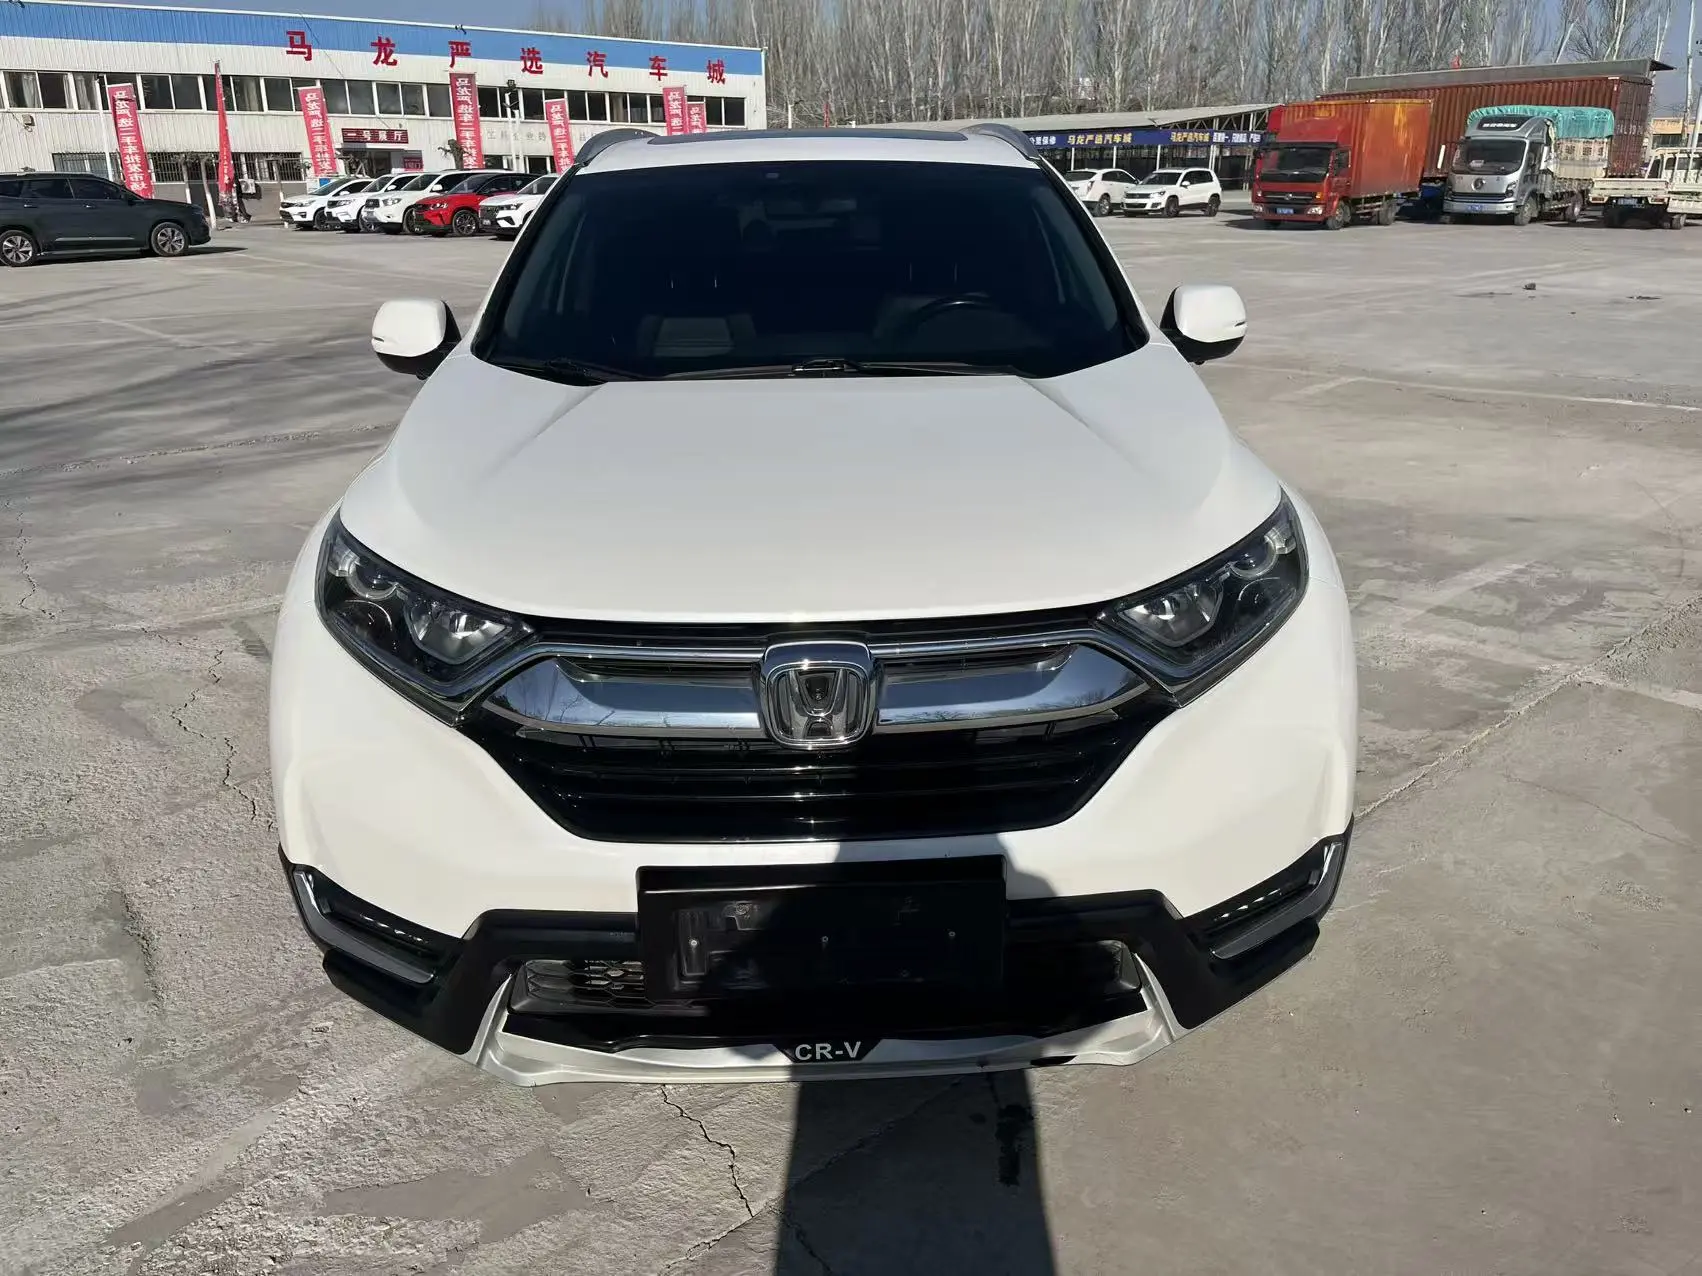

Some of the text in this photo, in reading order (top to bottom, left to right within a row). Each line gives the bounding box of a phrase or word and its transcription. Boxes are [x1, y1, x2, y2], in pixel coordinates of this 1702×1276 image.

[285, 30, 726, 85] 马龙严选汽车城
[346, 129, 403, 142] 一号展厅
[794, 1041, 863, 1063] CR-V
